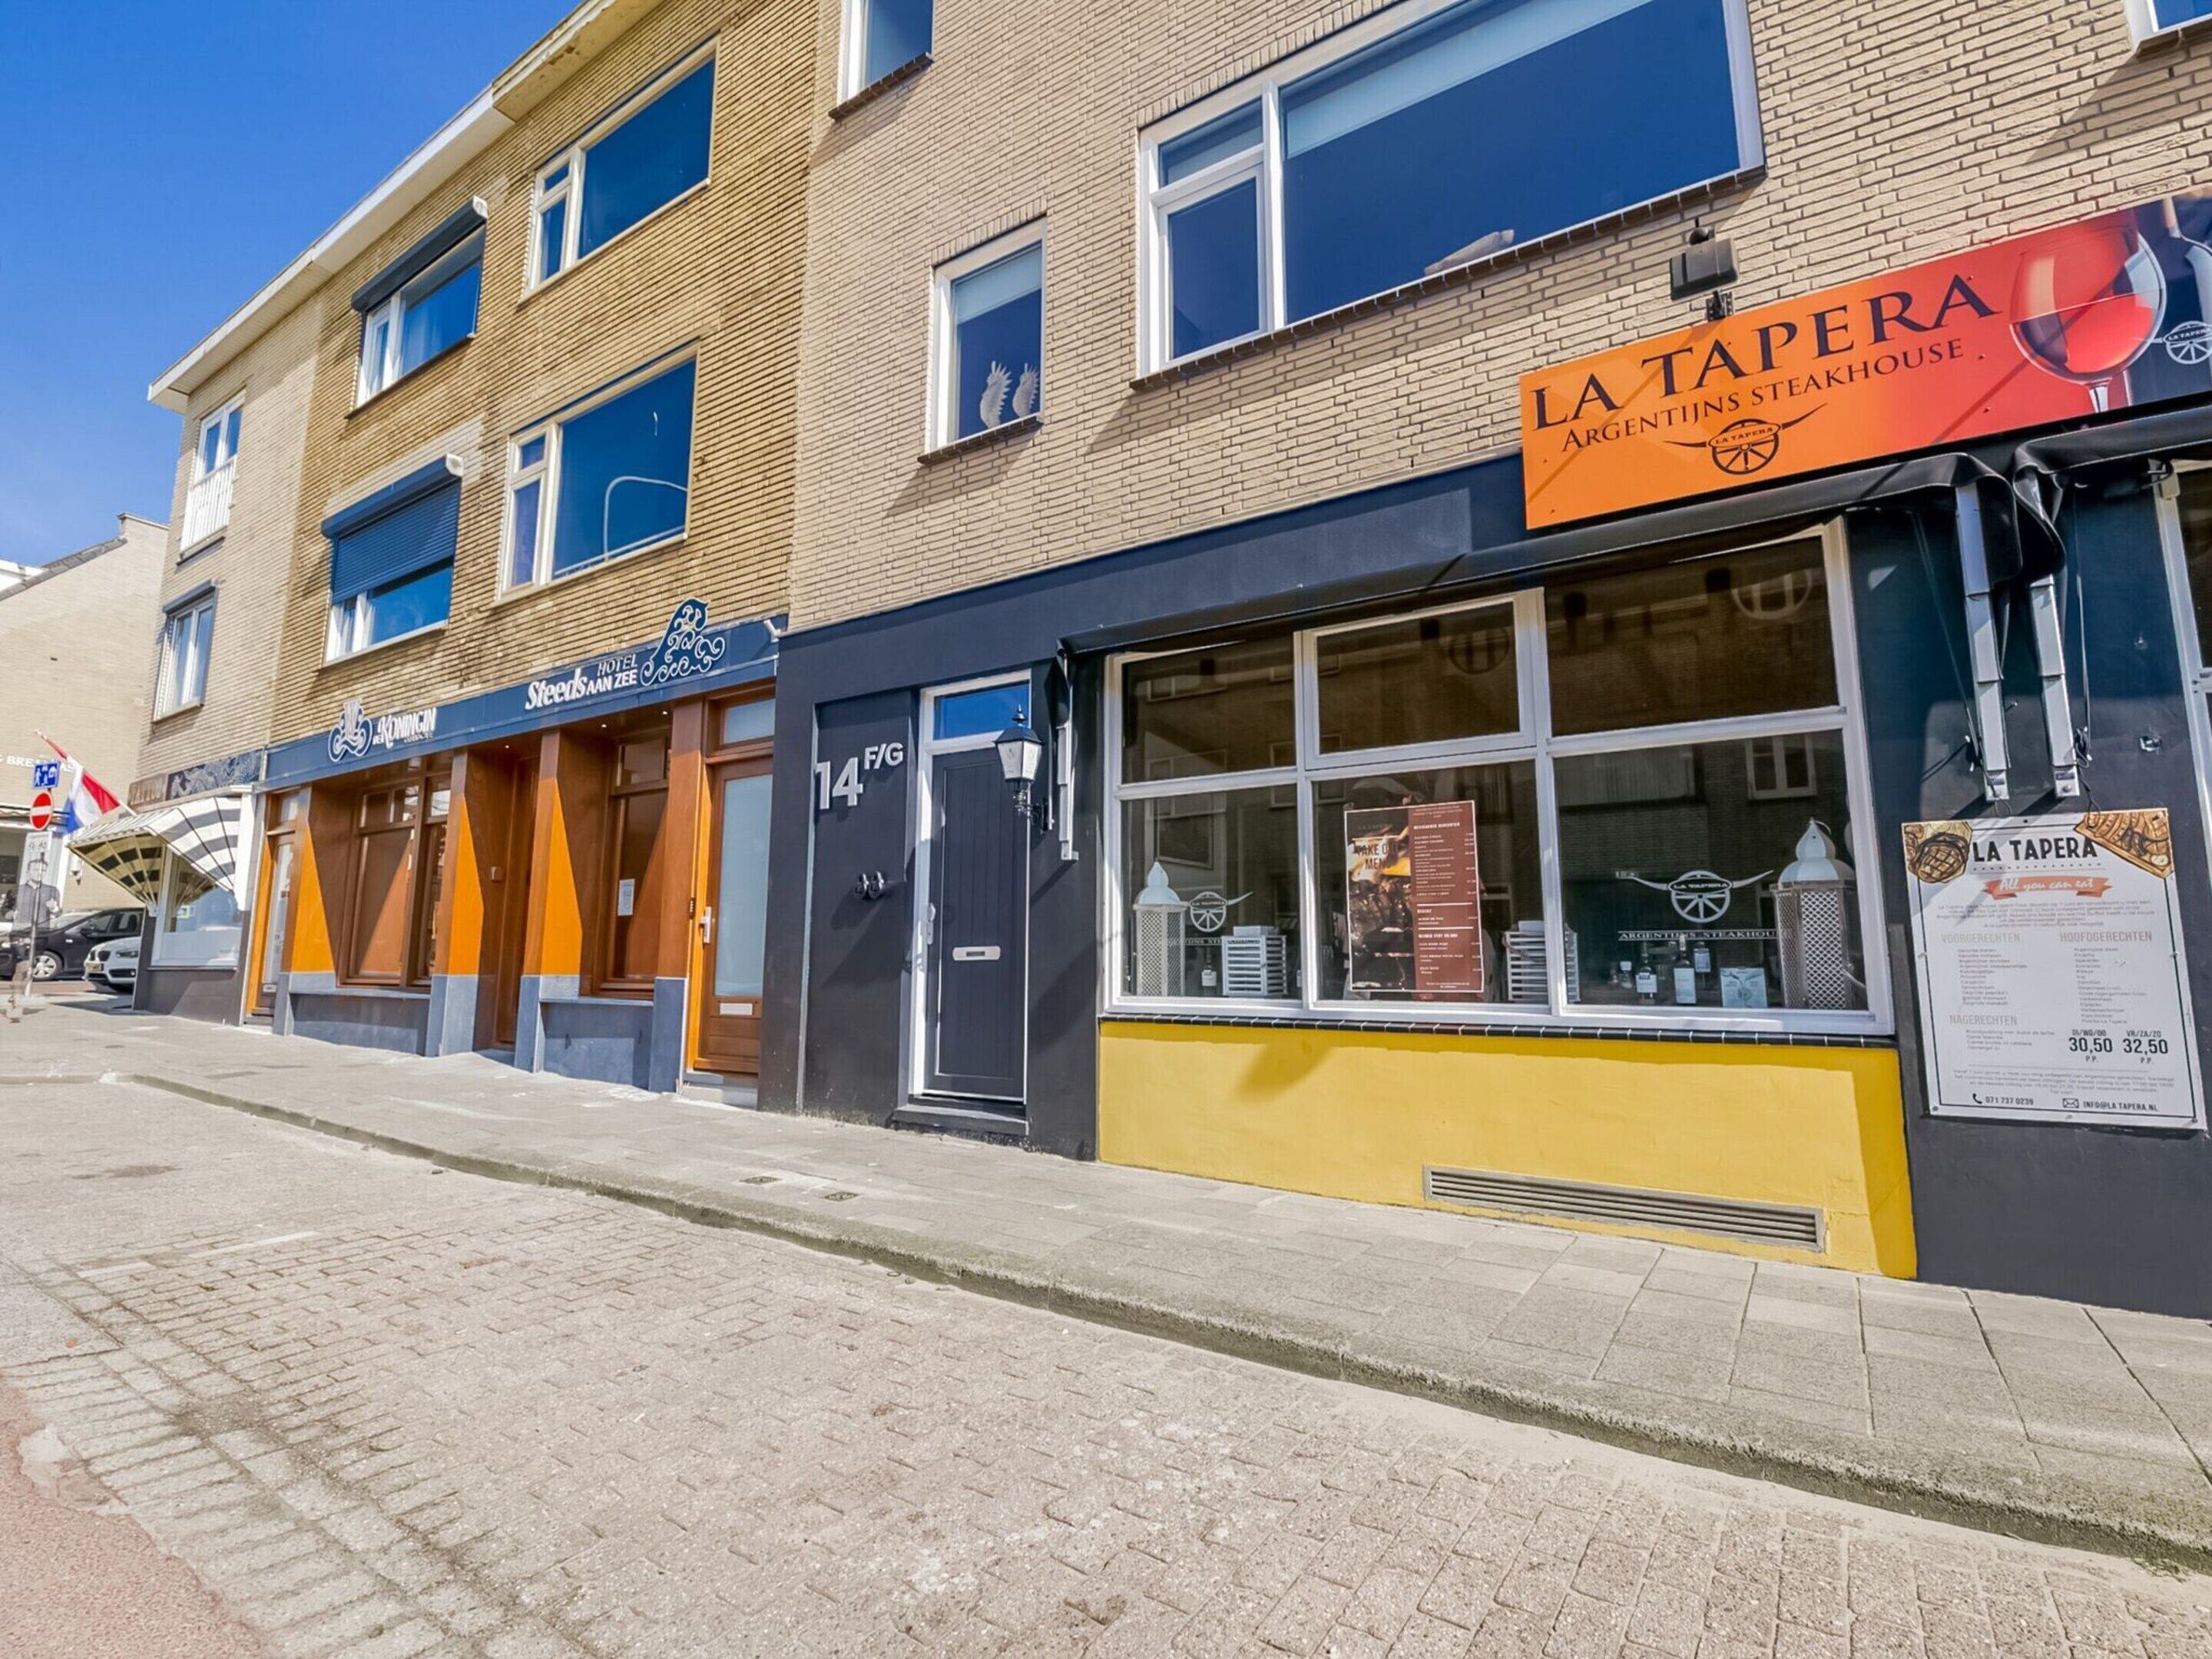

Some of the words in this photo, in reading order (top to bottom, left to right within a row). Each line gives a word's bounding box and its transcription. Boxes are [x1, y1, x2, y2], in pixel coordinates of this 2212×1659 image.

[1530, 373, 1626, 432] LA
[1641, 273, 2003, 399] TAPERA
[1562, 392, 1740, 452] ARGENTIJNS
[1751, 338, 1964, 406] STEAKHOUSE
[1730, 427, 1773, 441] TAPERA
[597, 653, 638, 677] HOTEL
[525, 667, 588, 710] Steeds
[586, 674, 612, 697] AAN
[614, 668, 638, 690] ZEE
[378, 707, 437, 750] KONINGIN
[814, 757, 863, 810] 14
[863, 742, 904, 770] F/G
[1972, 840, 2002, 863] LA
[2008, 836, 2098, 861] TAPERA
[1365, 857, 1391, 870] MEN
[2000, 878, 2018, 891] All
[2023, 883, 2046, 892] you
[1702, 930, 1776, 939] STEAKHOU
[1940, 932, 2022, 944] VOORGERECHTEN
[2059, 930, 2153, 942] HOOFDGERECHTEN
[1949, 1015, 2018, 1026] NAGERECHTEN
[2068, 1037, 2113, 1054] 30,50
[2122, 1038, 2168, 1055] 32,50
